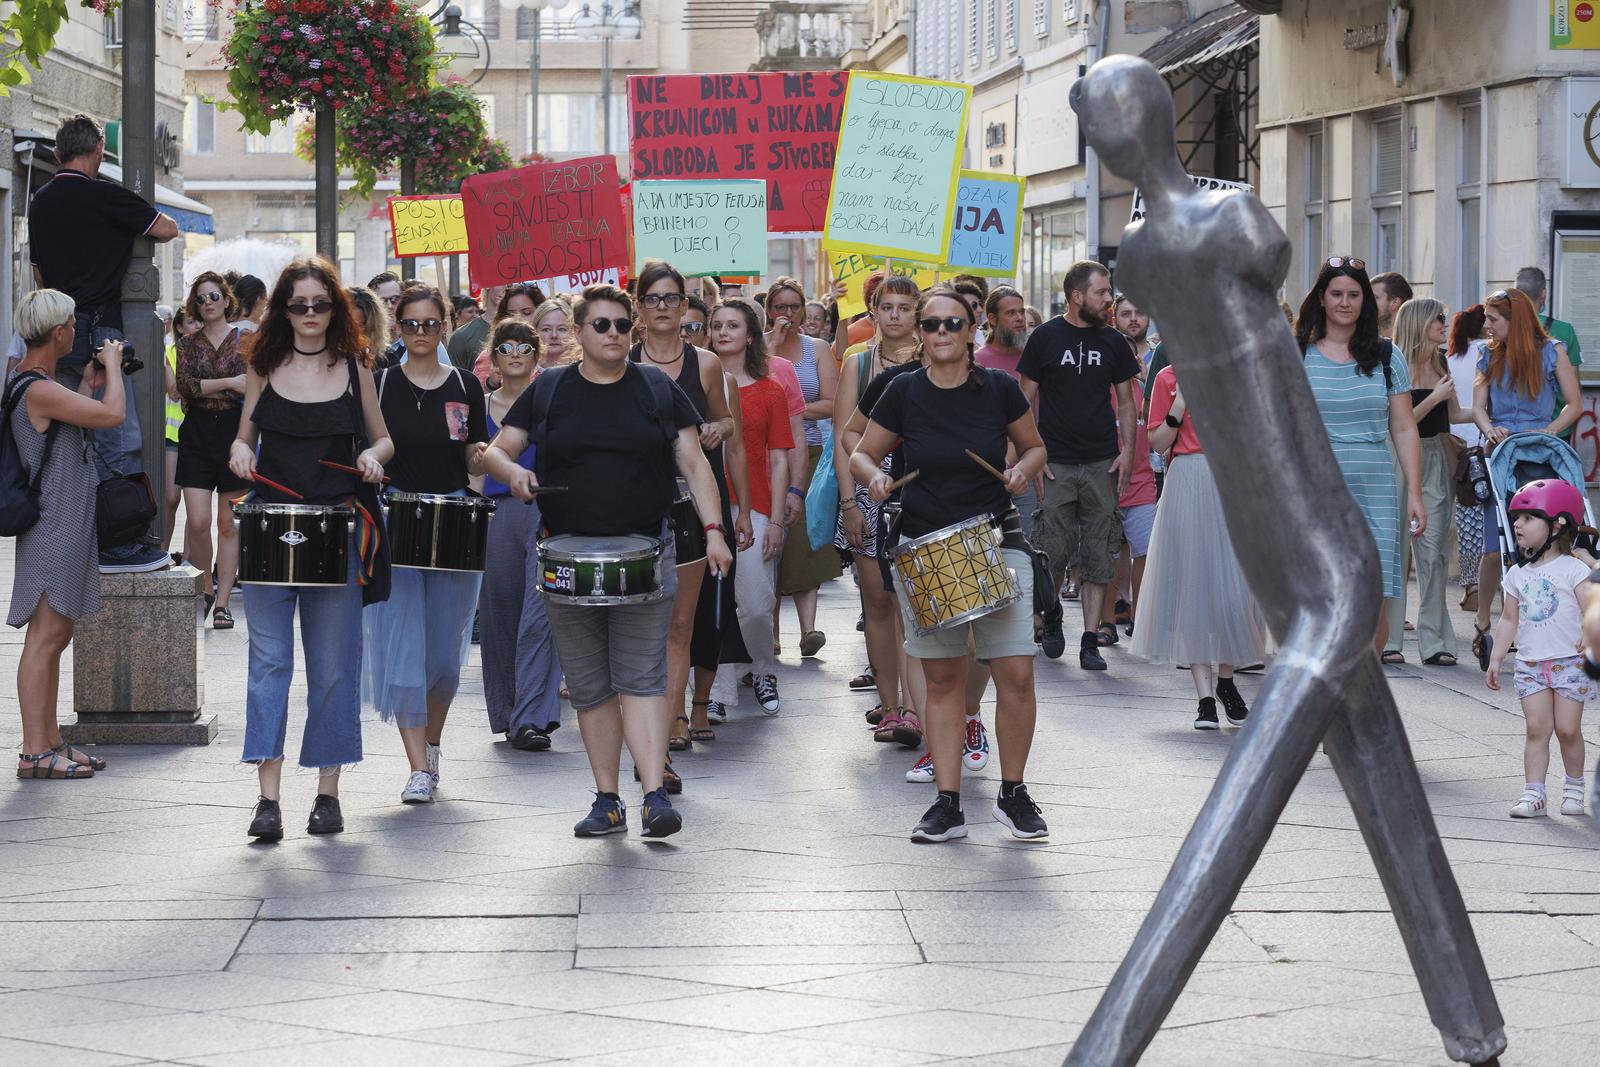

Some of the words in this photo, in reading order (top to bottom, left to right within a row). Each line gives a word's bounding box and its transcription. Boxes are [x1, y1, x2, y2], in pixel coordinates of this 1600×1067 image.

[637, 76, 667, 104] NE
[701, 75, 761, 104] DIRAJ
[784, 72, 815, 98] ME
[828, 72, 844, 97] S
[859, 80, 964, 113] SLOBODO,
[635, 107, 737, 139] KRUNICOM
[847, 114, 864, 127] o
[634, 145, 718, 177] SLOBODA
[734, 143, 755, 170] JE
[876, 143, 923, 163] slatka,
[542, 162, 604, 193] IZBOR
[842, 162, 880, 180] dar
[892, 163, 924, 193] koji
[637, 192, 648, 209] A
[649, 193, 665, 210] DA
[669, 193, 719, 209] UMJESTO
[725, 193, 765, 209] FETUSA
[959, 186, 1008, 204] OZAK
[493, 189, 594, 232] SAVJESTI
[839, 191, 873, 208] nam
[884, 195, 922, 212] naša
[920, 202, 939, 224] je
[551, 218, 611, 241] IZAZIVA
[640, 215, 708, 234] BRINEMO
[724, 216, 739, 231] O
[828, 213, 888, 234] BORBA
[896, 219, 935, 237] DALA
[669, 236, 719, 253] DJECI
[497, 238, 605, 280] GADOSTI
[968, 249, 1008, 268] VIJEK
[556, 566, 570, 577] ZG
[607, 809, 619, 824] N
